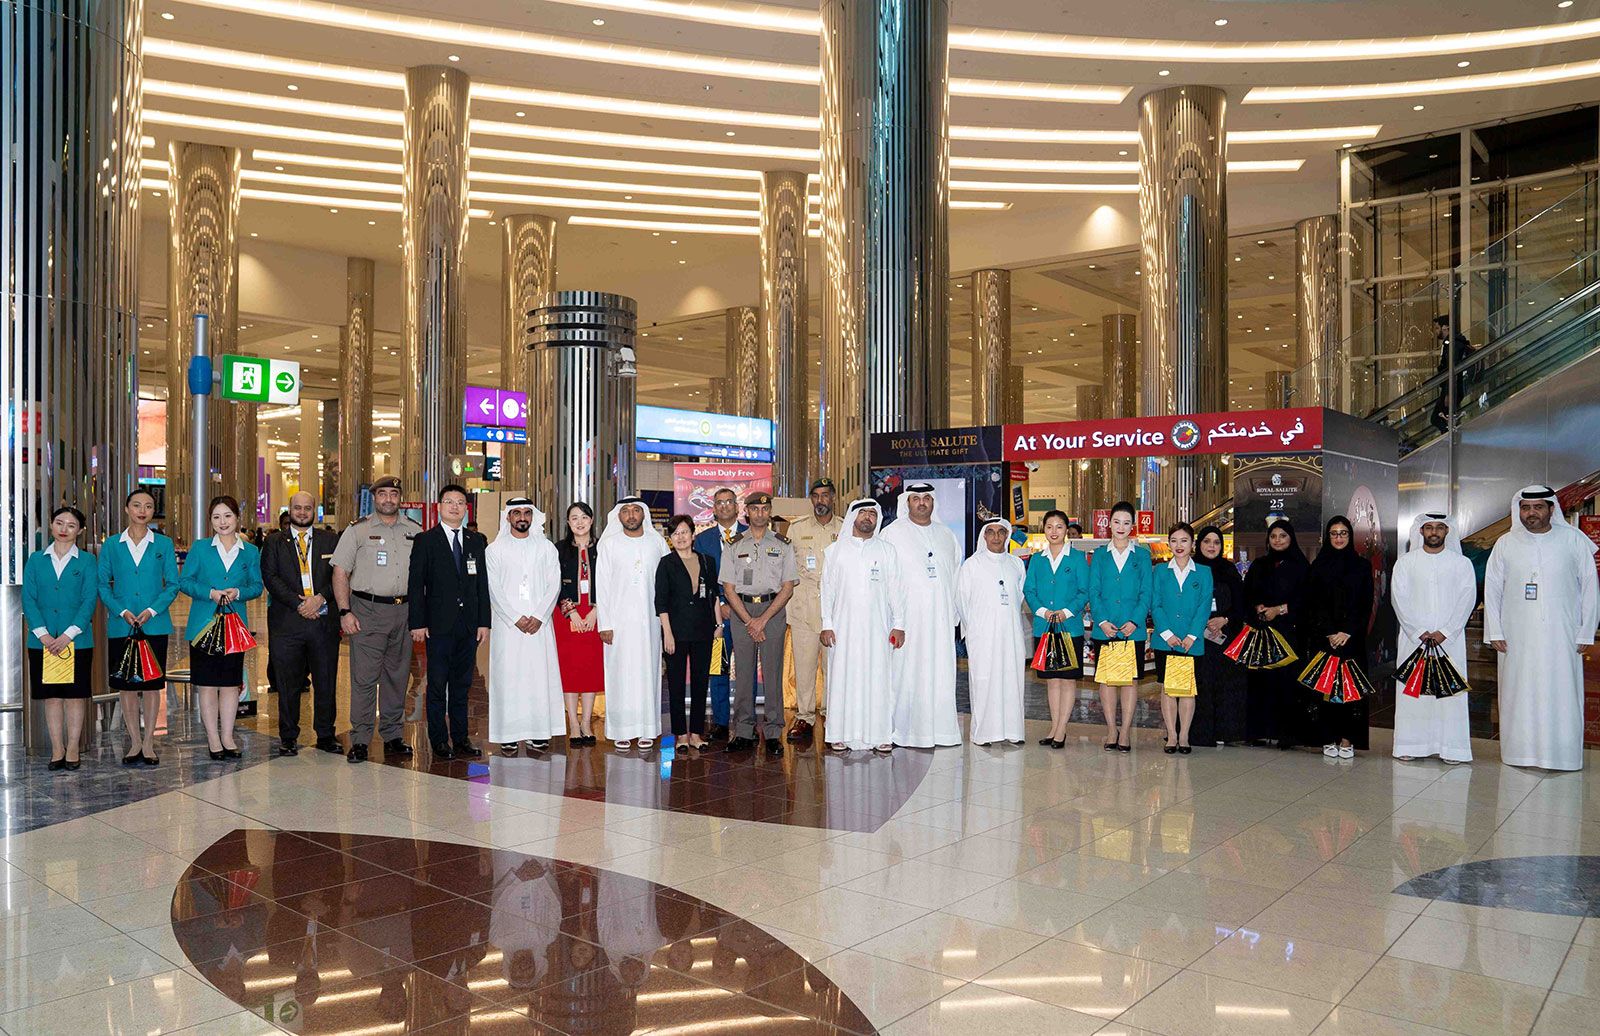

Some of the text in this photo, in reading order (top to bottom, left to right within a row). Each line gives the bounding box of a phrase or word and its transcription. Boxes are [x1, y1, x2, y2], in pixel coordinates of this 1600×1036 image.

[1207, 420, 1273, 446] خدمتكم
[1280, 417, 1305, 446] في
[891, 435, 978, 450] ROYAL SALUTE
[1013, 435, 1037, 451] At
[1041, 433, 1087, 450] Your
[1092, 428, 1165, 448] Service
[899, 448, 969, 458] THE ULTIMATE GIFT
[717, 469, 737, 478] Duty
[737, 469, 755, 477] Free
[1270, 498, 1285, 509] 25
[1096, 517, 1109, 528] 40
[1140, 516, 1151, 526] 40
